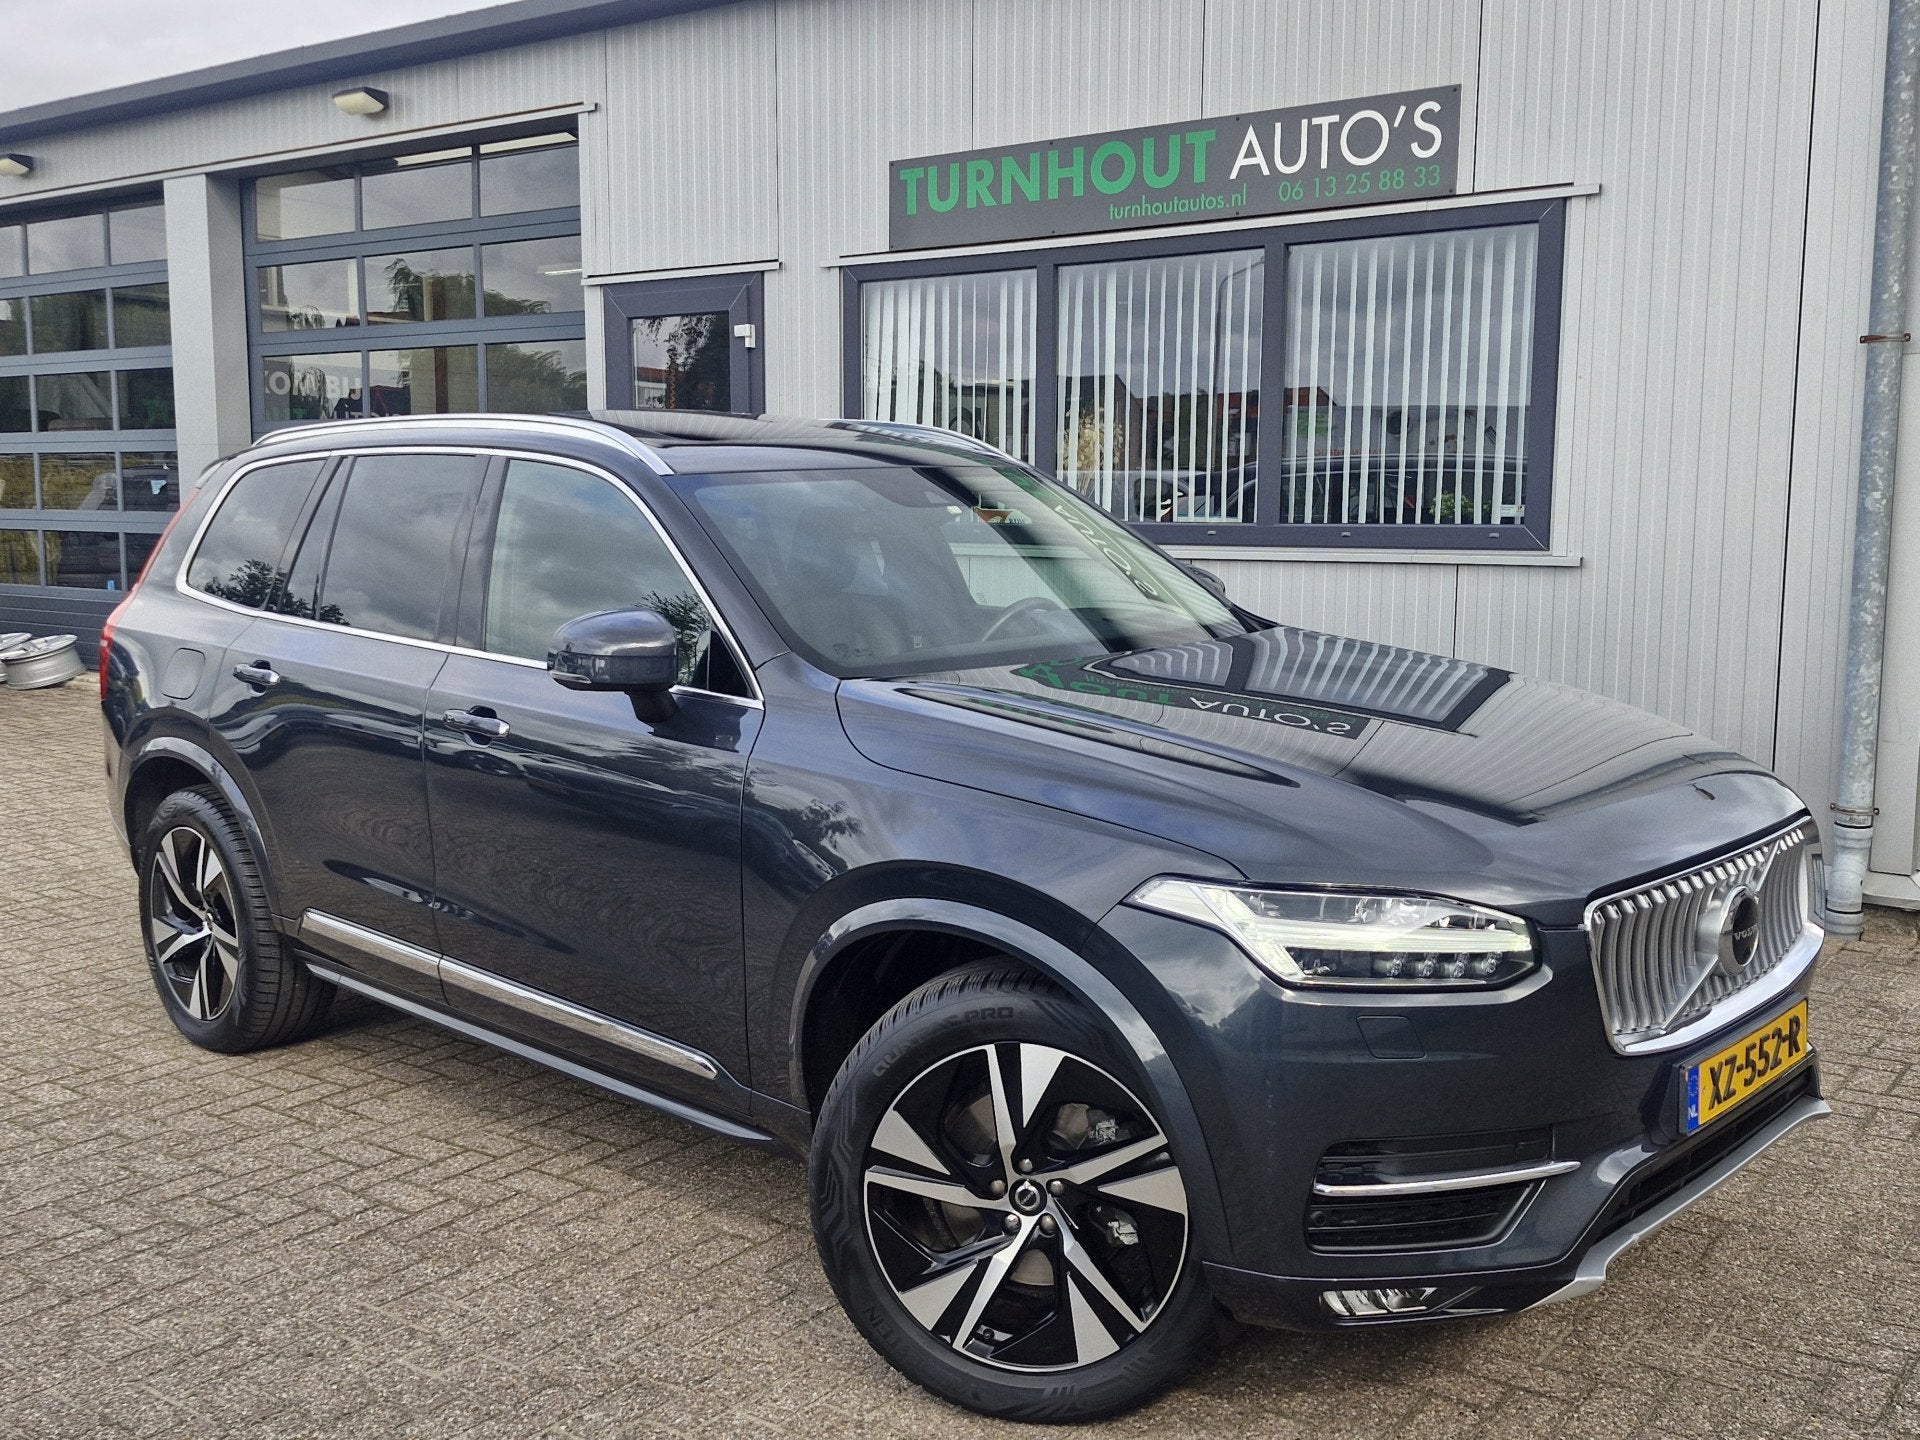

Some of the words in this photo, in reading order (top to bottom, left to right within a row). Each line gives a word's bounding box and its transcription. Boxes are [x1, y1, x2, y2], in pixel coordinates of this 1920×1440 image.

[898, 129, 1217, 217] TURNHOUT
[1229, 100, 1442, 180] AUTO'S
[1278, 180, 1304, 202] 06
[1313, 176, 1337, 199] 13
[1344, 171, 1372, 196] 25
[1377, 168, 1406, 192] 88
[1413, 164, 1441, 189] 33
[1107, 185, 1247, 221] turnhoutautos.nl
[963, 1006, 1014, 1023] PRO
[1708, 1014, 1801, 1111] XZ-552-R
[1688, 1104, 1698, 1120] NL
